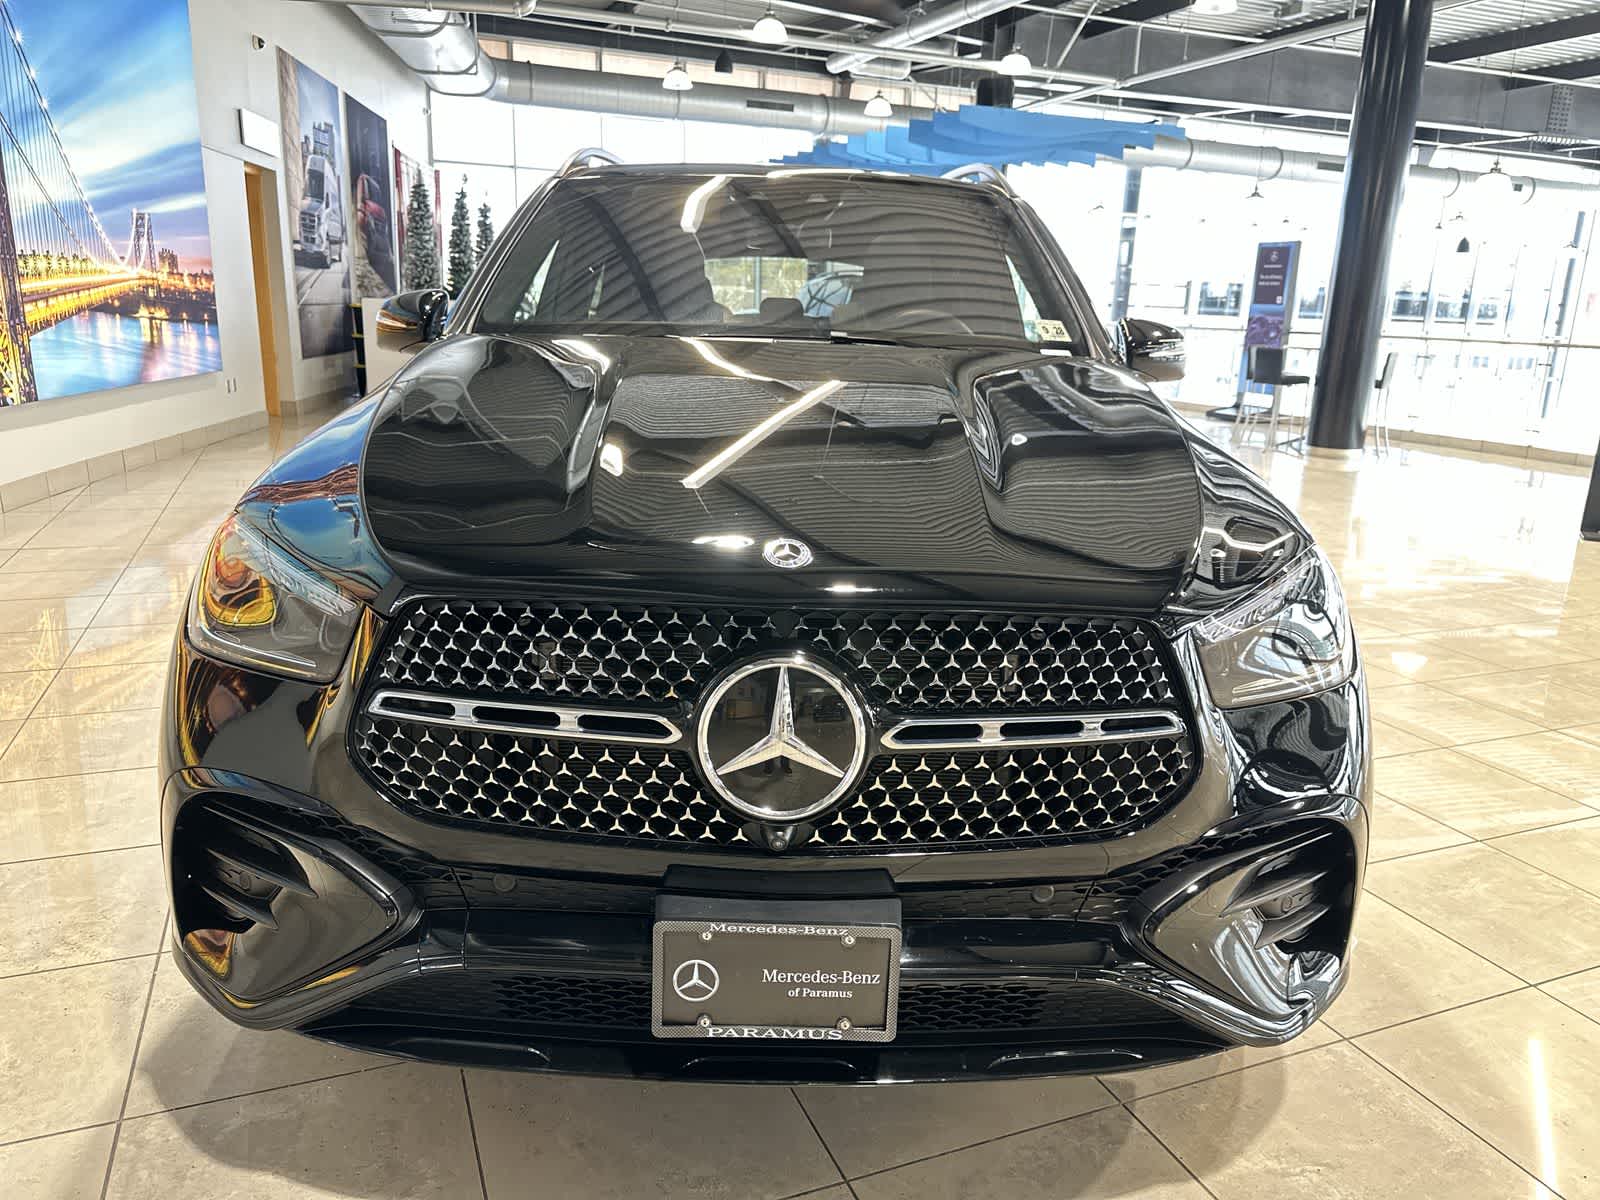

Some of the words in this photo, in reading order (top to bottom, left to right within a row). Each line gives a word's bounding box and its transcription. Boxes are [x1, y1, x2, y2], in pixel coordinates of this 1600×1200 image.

[709, 923, 849, 936] Mercedes-Benz
[762, 968, 880, 985] Mercedes-Benz
[787, 988, 800, 998] of
[802, 988, 853, 999] Paramus
[706, 1028, 843, 1040] PARAMUS
